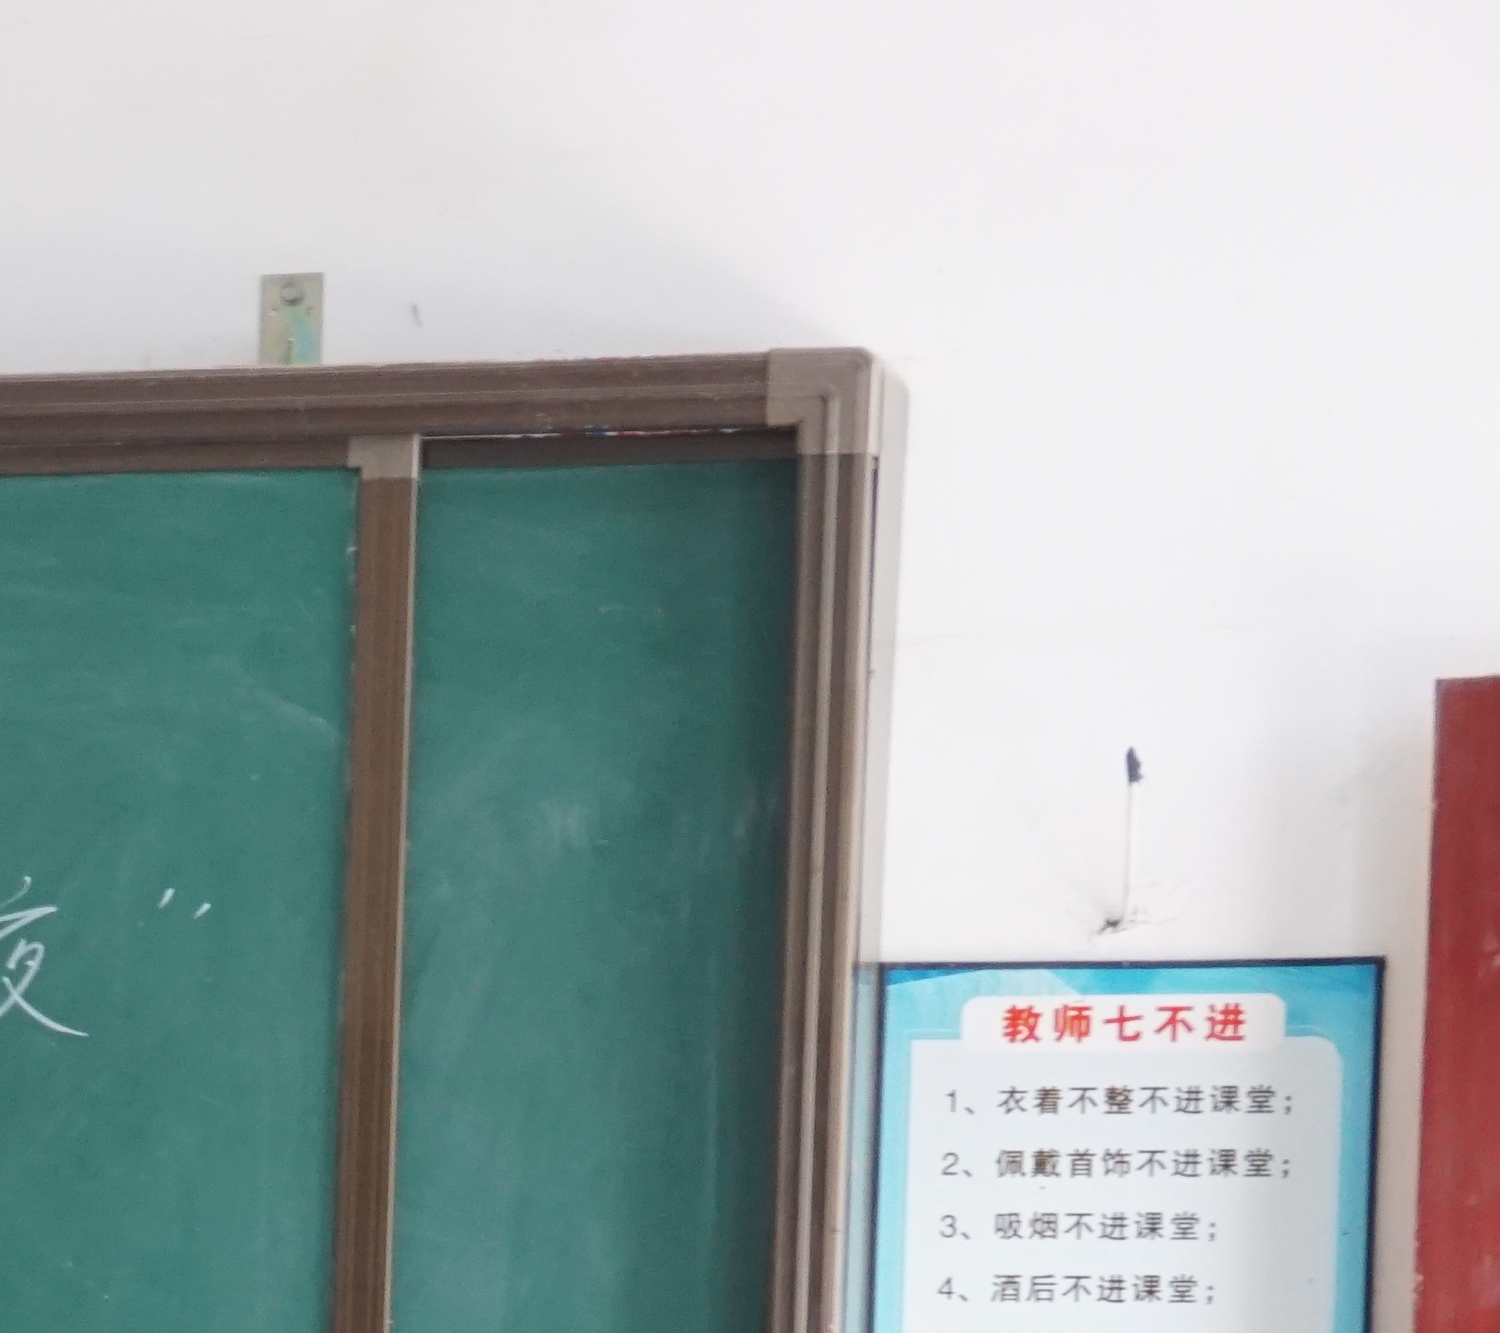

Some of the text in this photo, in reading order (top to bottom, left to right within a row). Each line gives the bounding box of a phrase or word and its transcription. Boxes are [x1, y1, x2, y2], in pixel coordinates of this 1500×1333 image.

[1001, 1003, 1248, 1044] 教师七不进
